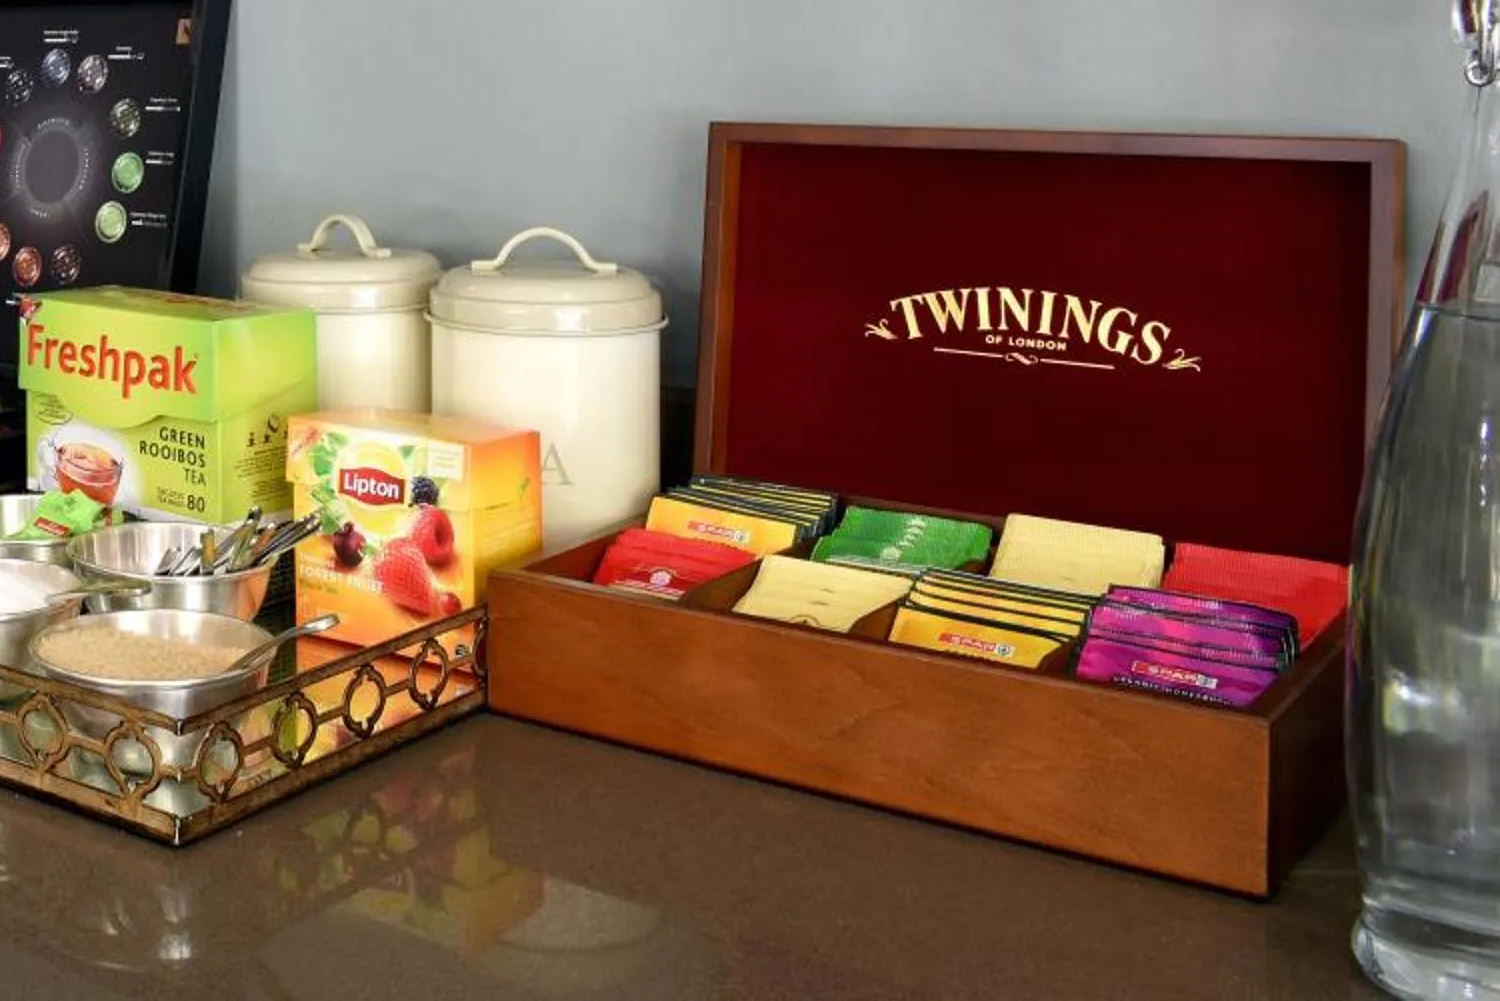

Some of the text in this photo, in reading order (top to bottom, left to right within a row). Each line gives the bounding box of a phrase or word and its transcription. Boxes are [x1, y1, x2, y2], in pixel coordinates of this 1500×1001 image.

[889, 286, 1171, 365] TWININGS
[985, 335, 1067, 351] OF LONDON
[27, 324, 197, 399] Freshpak
[160, 426, 205, 450] GREEN
[139, 440, 206, 468] ROOIBOS
[183, 467, 207, 487] TEA
[343, 472, 399, 500] Lipton
[187, 495, 205, 513] 80
